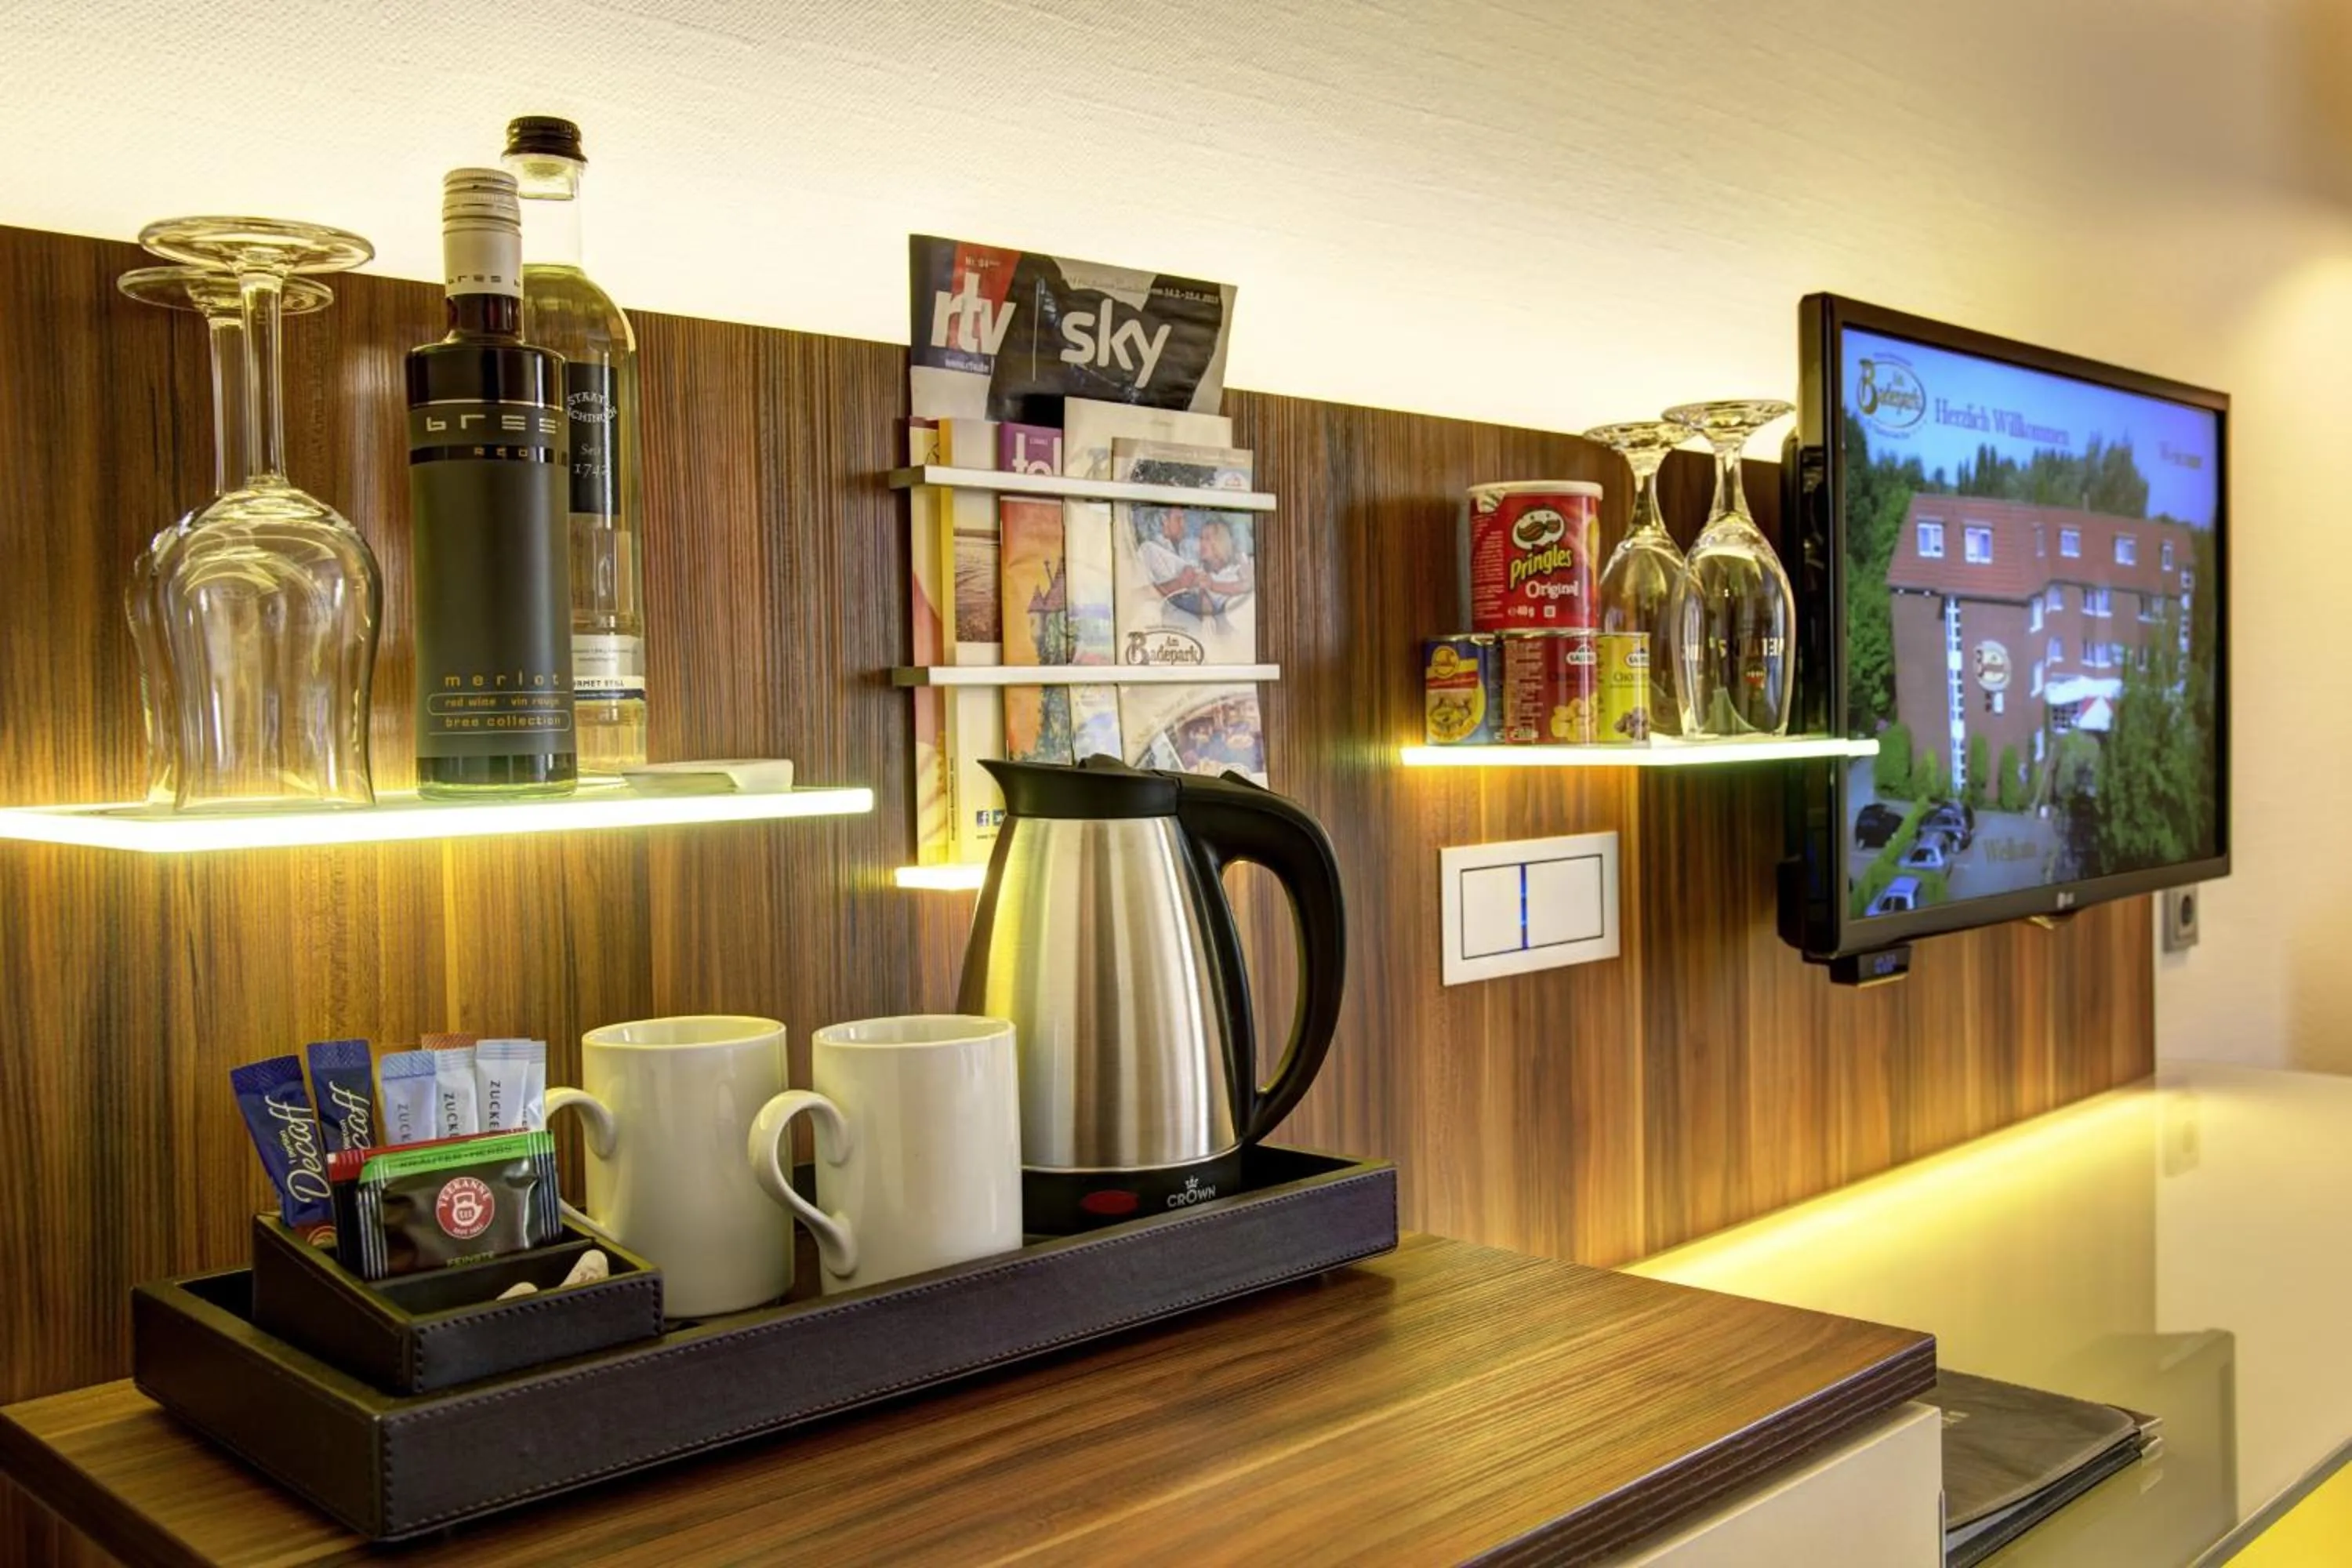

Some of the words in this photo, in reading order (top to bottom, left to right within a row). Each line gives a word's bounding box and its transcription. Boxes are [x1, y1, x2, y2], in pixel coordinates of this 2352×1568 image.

[931, 272, 1017, 355] rtv
[1060, 297, 1172, 389] sky
[1510, 544, 1572, 590] Pringles
[1526, 580, 1579, 599] Original
[445, 670, 560, 687] merlot
[487, 715, 561, 728] collection
[329, 1080, 371, 1149] caff
[397, 1103, 412, 1142] ZUCK
[444, 1092, 459, 1137] ZUCK
[489, 1080, 501, 1131] ZUCKE
[1167, 1185, 1216, 1208] CROWN
